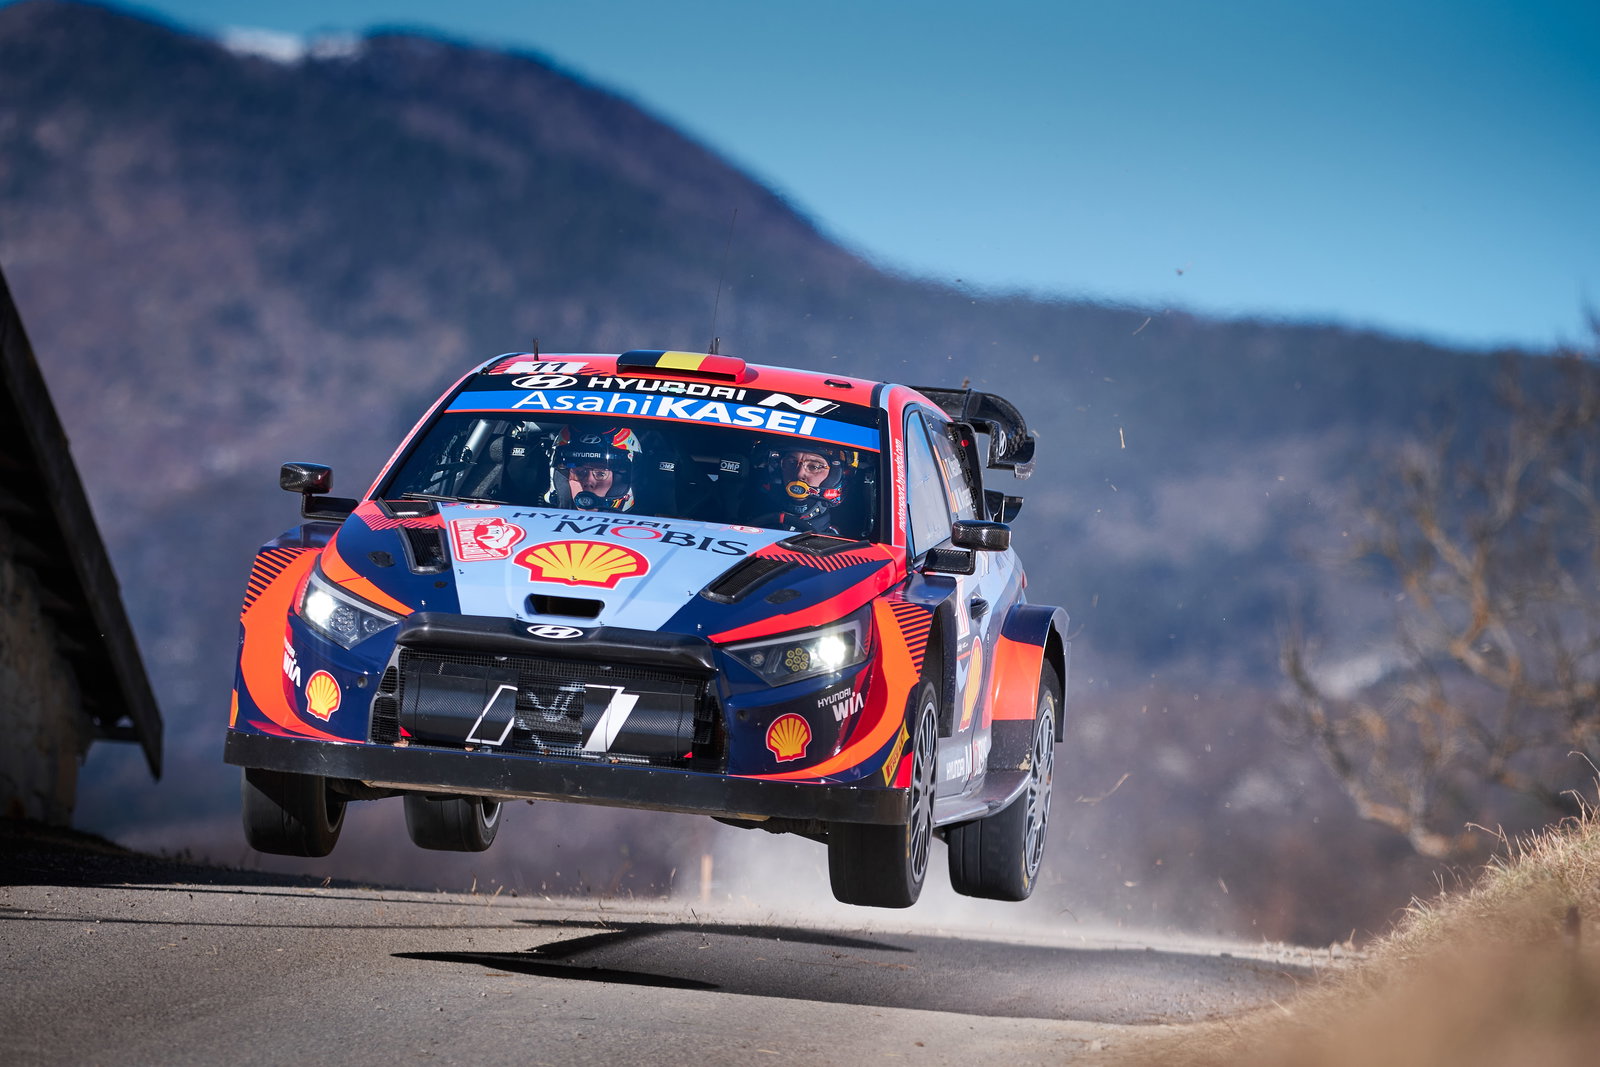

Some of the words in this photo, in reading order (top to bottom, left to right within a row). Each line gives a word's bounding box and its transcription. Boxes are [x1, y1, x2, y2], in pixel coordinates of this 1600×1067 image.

[532, 362, 564, 372] 11
[588, 377, 746, 400] HYUNDAI
[720, 461, 740, 471] OMP
[512, 512, 672, 529] HYUNDAI
[552, 520, 749, 556] MOBIS
[817, 687, 851, 708] HYUNDAI
